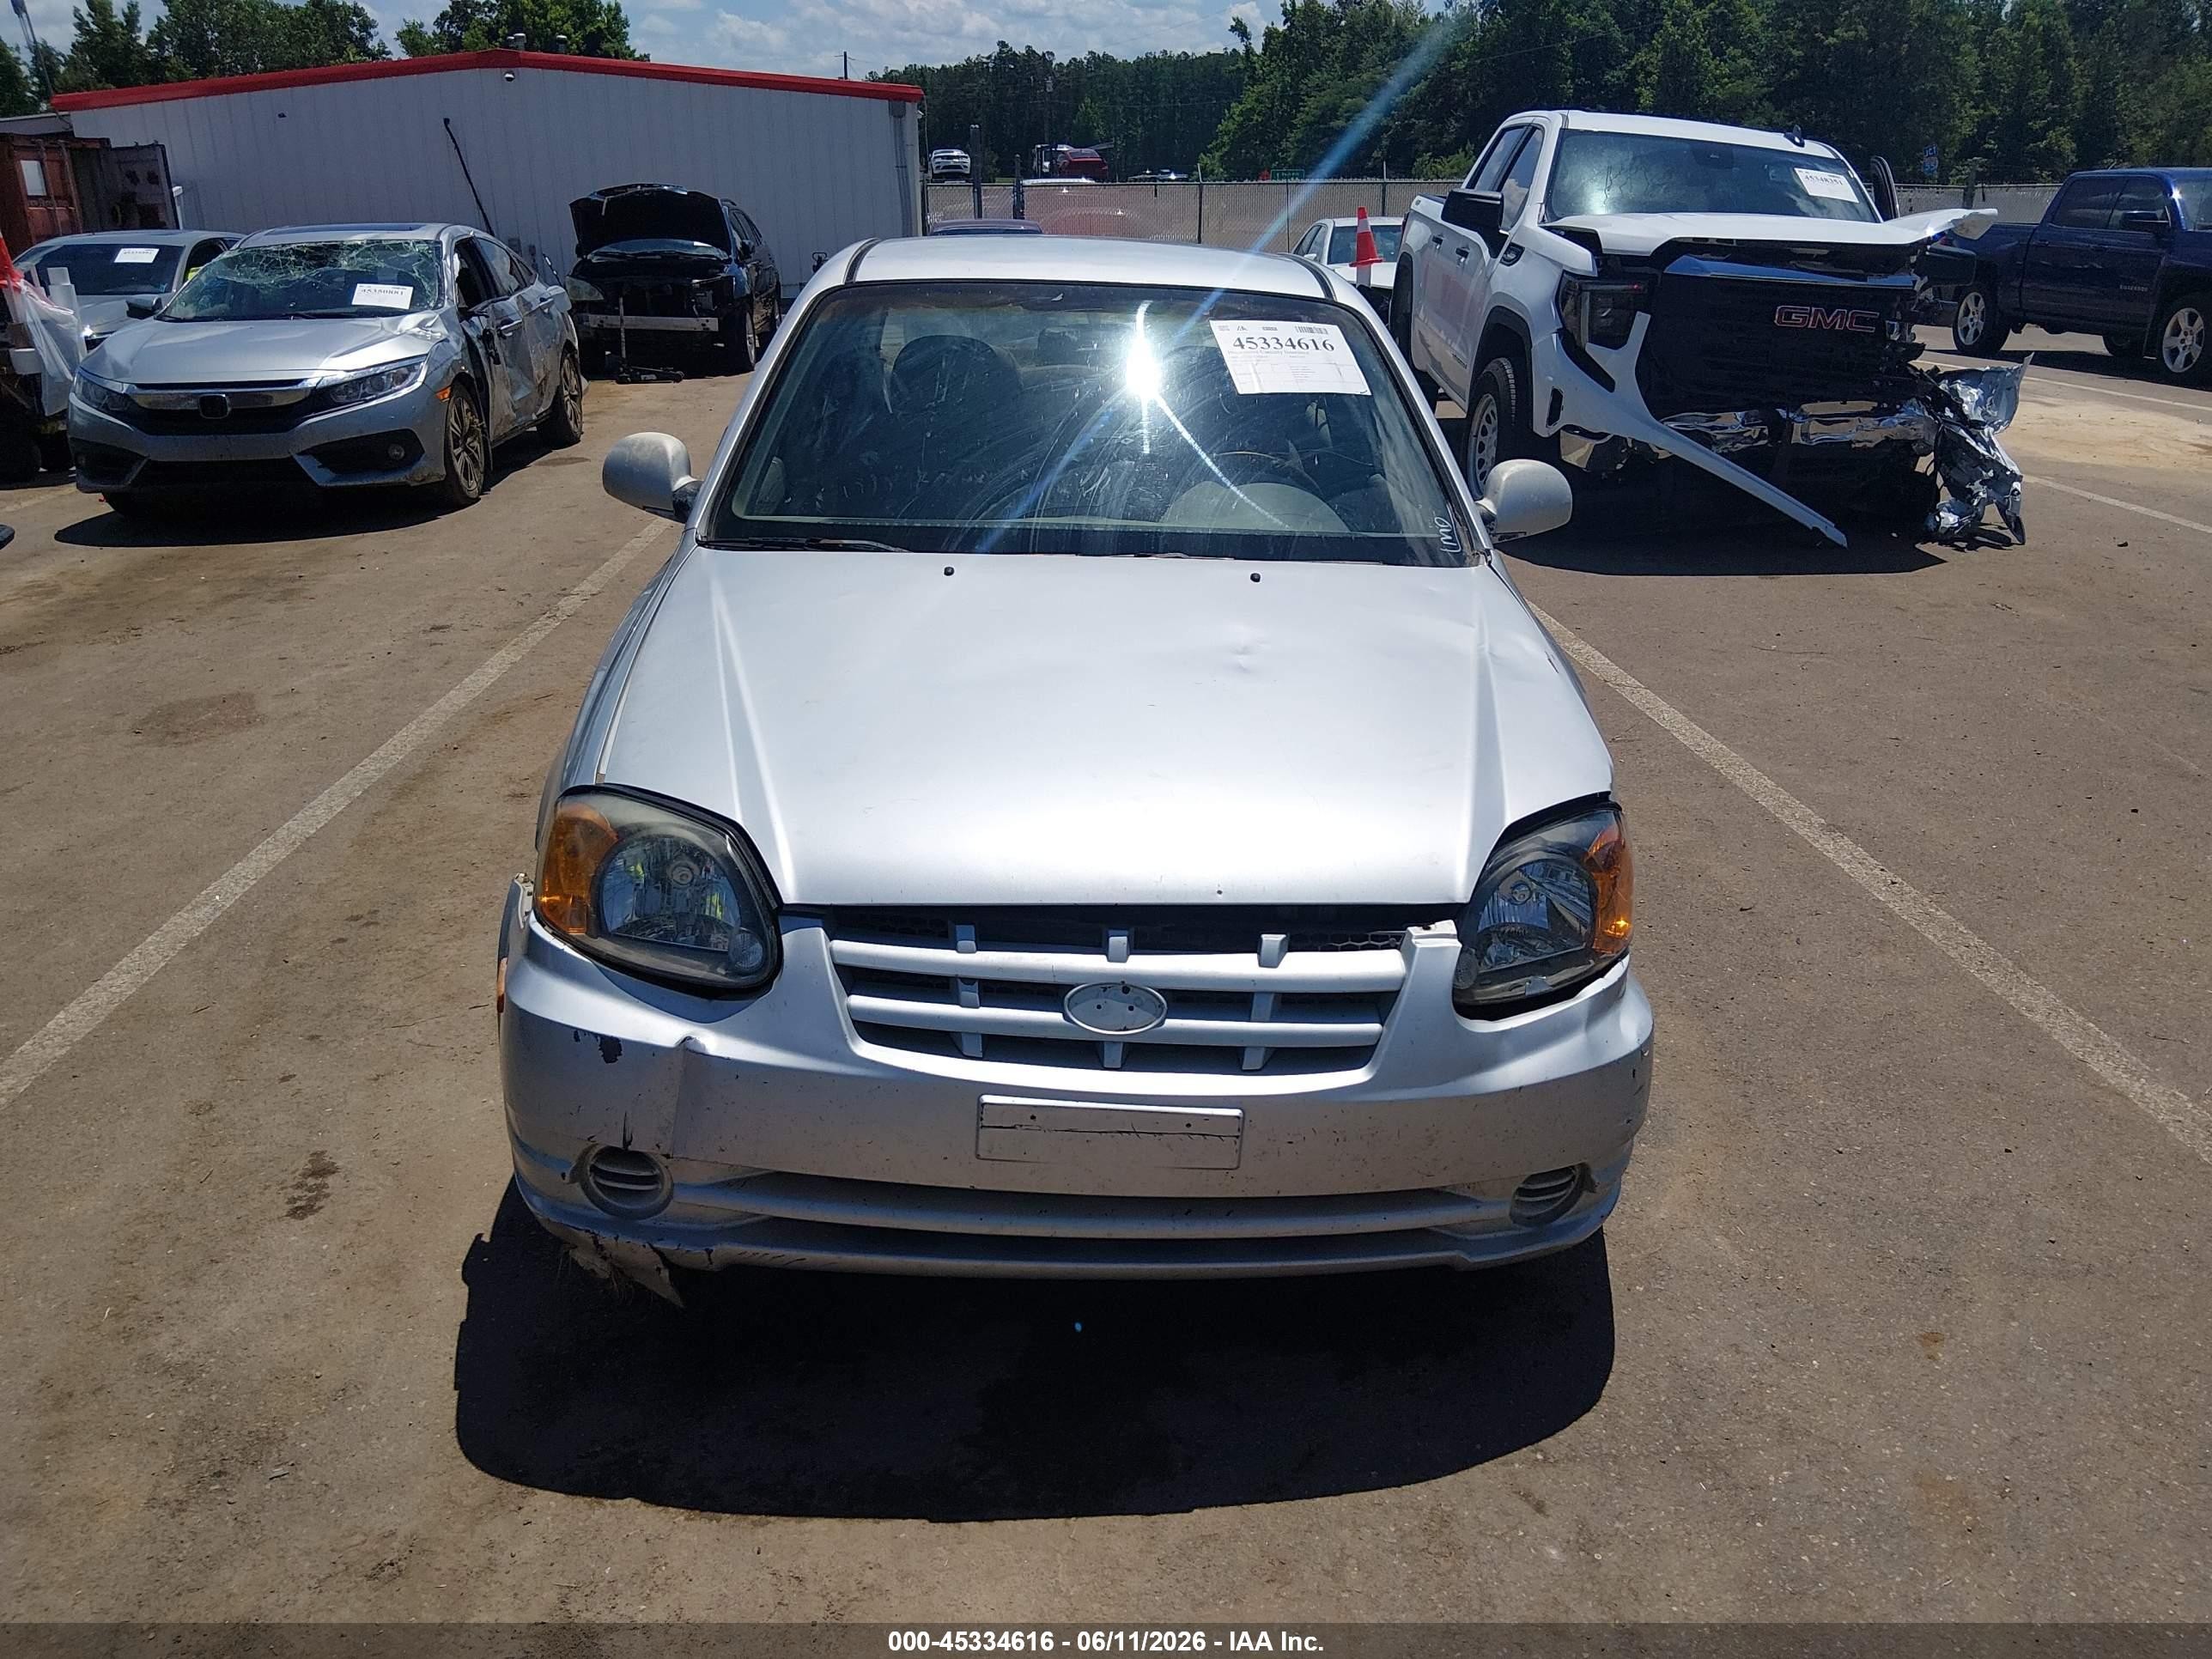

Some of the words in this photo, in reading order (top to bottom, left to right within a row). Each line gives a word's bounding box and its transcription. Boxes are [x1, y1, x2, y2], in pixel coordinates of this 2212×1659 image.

[1924, 146, 1936, 156] JCT
[1774, 305, 1880, 333] GMC
[1232, 337, 1334, 352] 45334616
